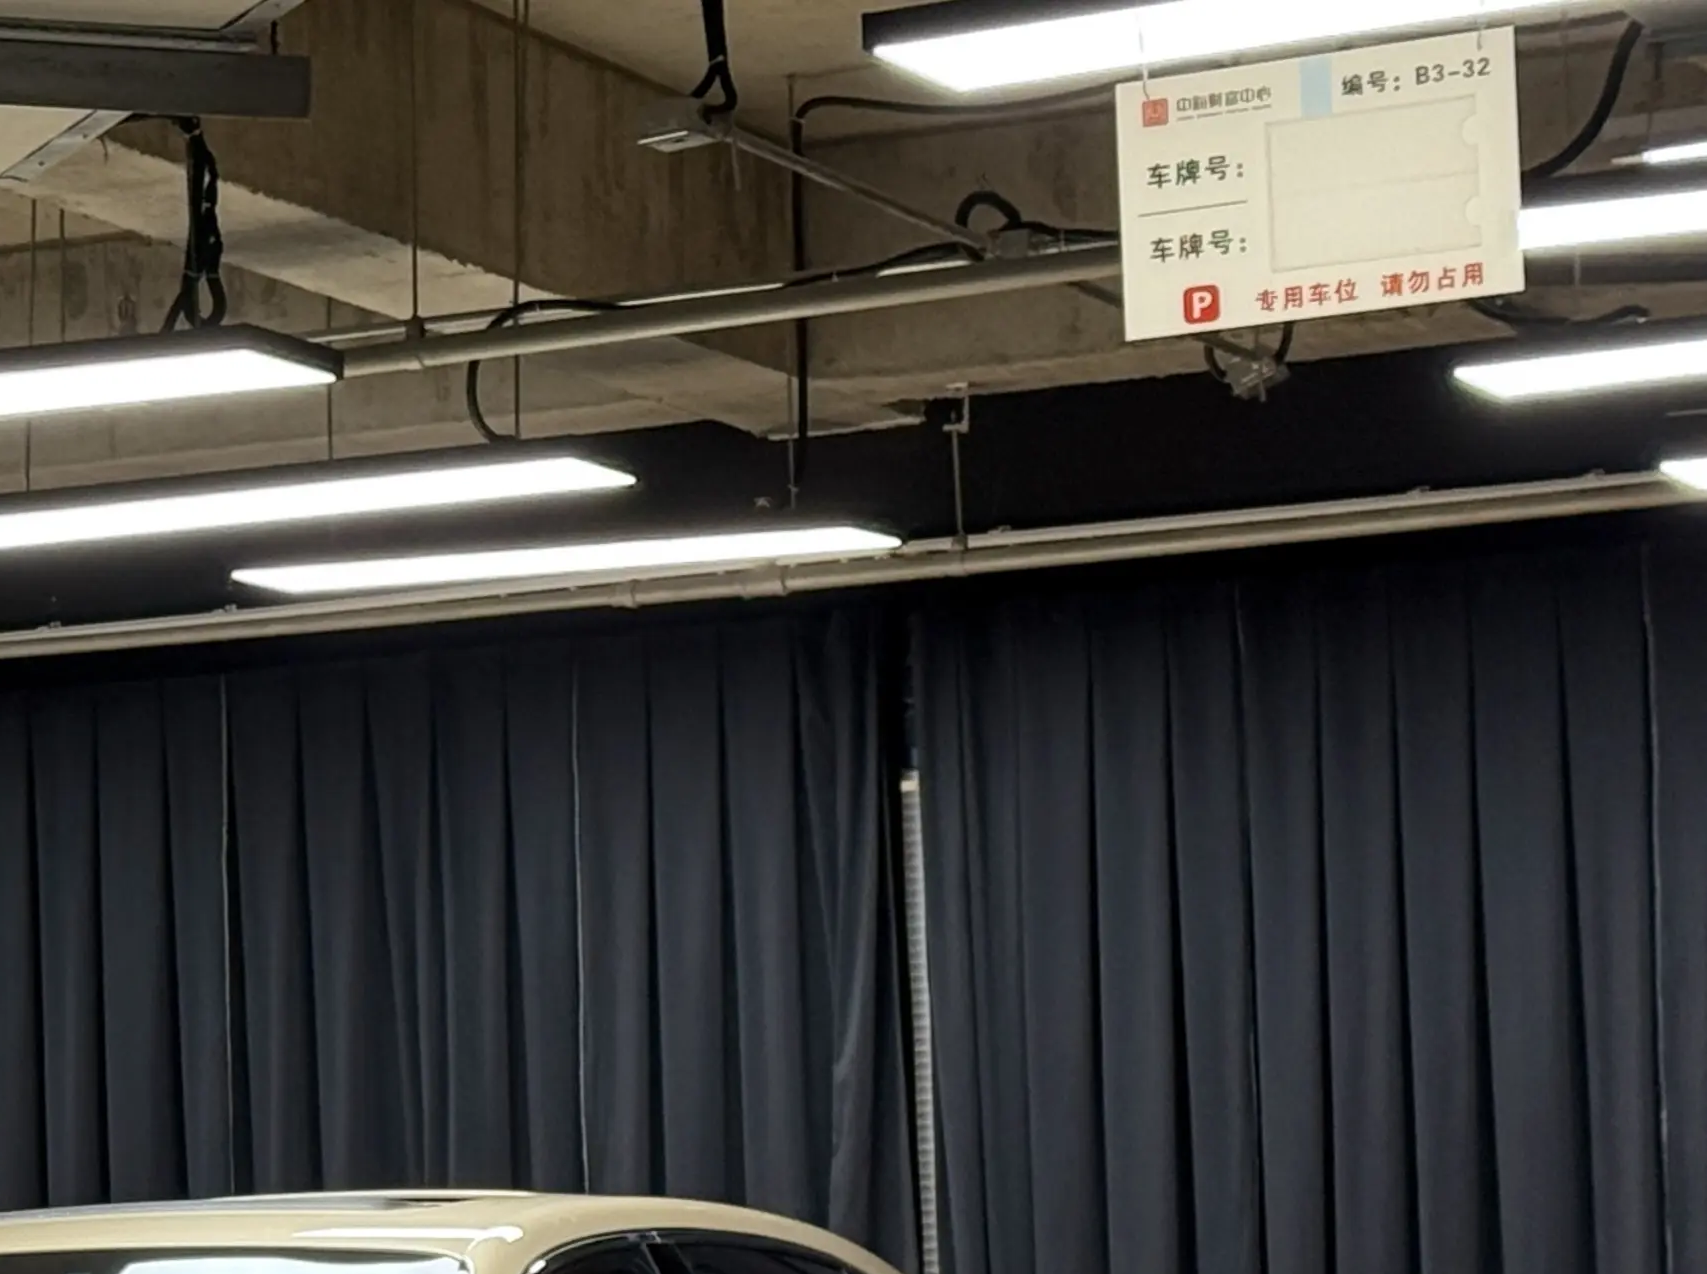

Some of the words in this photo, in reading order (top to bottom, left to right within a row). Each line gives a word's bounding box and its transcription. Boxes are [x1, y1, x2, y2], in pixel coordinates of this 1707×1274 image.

[1415, 57, 1491, 85] B3-32
[1147, 155, 1244, 189] 车牌号：
[1150, 229, 1247, 263] 车牌号：
[1255, 278, 1359, 312] 专用车位
[1380, 262, 1484, 298] 请勿占用
[1191, 290, 1213, 320] P
